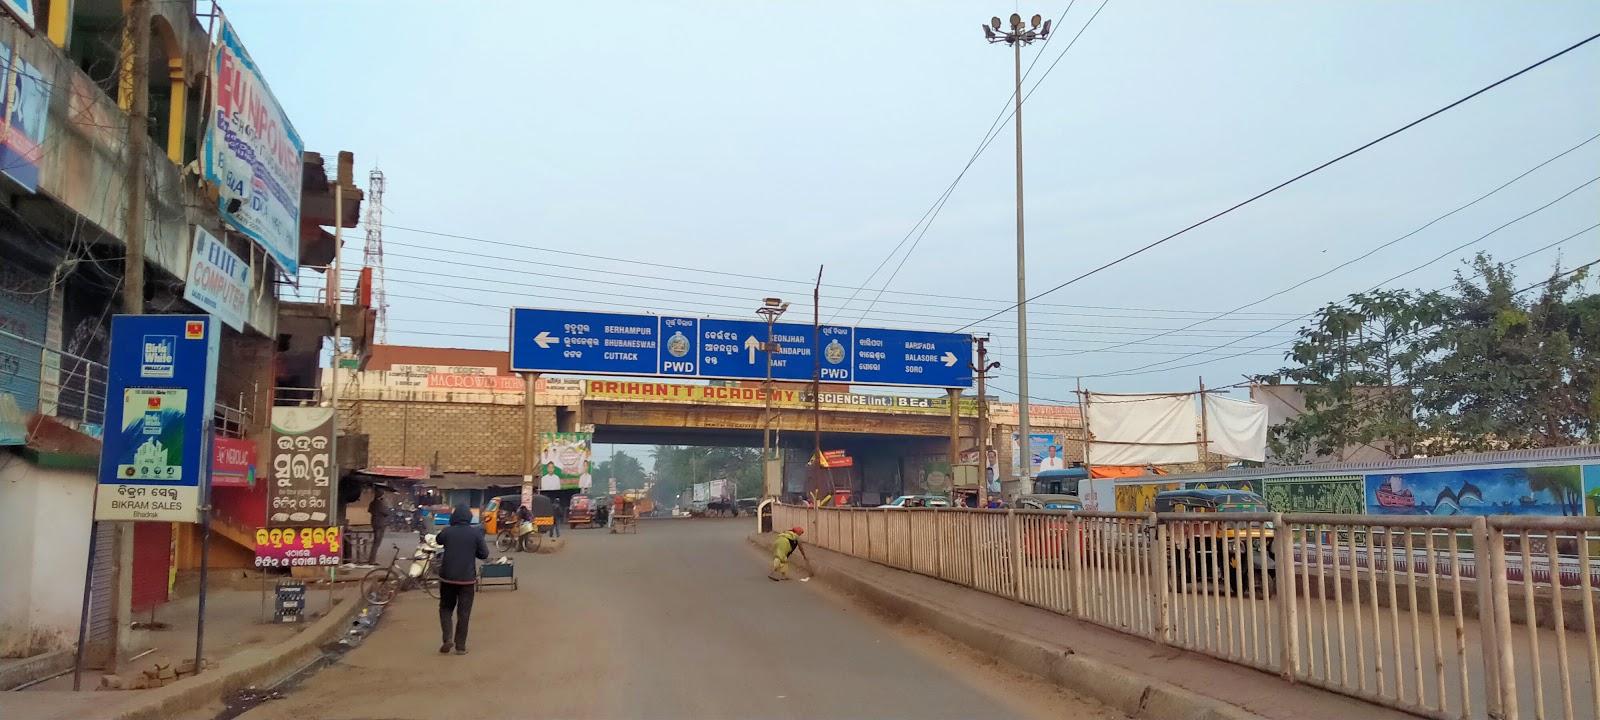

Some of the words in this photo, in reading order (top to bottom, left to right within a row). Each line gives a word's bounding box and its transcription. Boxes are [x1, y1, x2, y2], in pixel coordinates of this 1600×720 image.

[208, 241, 237, 277] ELITE
[194, 261, 245, 310] COMPUTER
[604, 325, 651, 335] BERHAMPUR
[145, 343, 167, 352] Birla
[604, 339, 656, 348] BHUBANESWAR
[604, 352, 638, 360] CUTTACK
[772, 347, 811, 355] ANDAPUR
[145, 352, 172, 363] White
[905, 353, 938, 362] BALASORE
[664, 361, 694, 372] PWD
[905, 365, 923, 373] SORO
[821, 368, 848, 379] PWD
[591, 381, 696, 397] ARIHANTT
[703, 386, 795, 402] ACADEMY
[817, 393, 866, 405] SCIENCE
[277, 436, 328, 452] ଭଦ୍ରକ
[118, 485, 146, 498] ବିକ୍ରମ
[112, 500, 149, 509] BIKRAM
[151, 501, 182, 510] SALES
[298, 500, 307, 508] ଓ
[309, 497, 326, 508] ମିଠା
[256, 528, 296, 548] ଭଦ୍ରକ
[281, 557, 289, 566] ଓ
